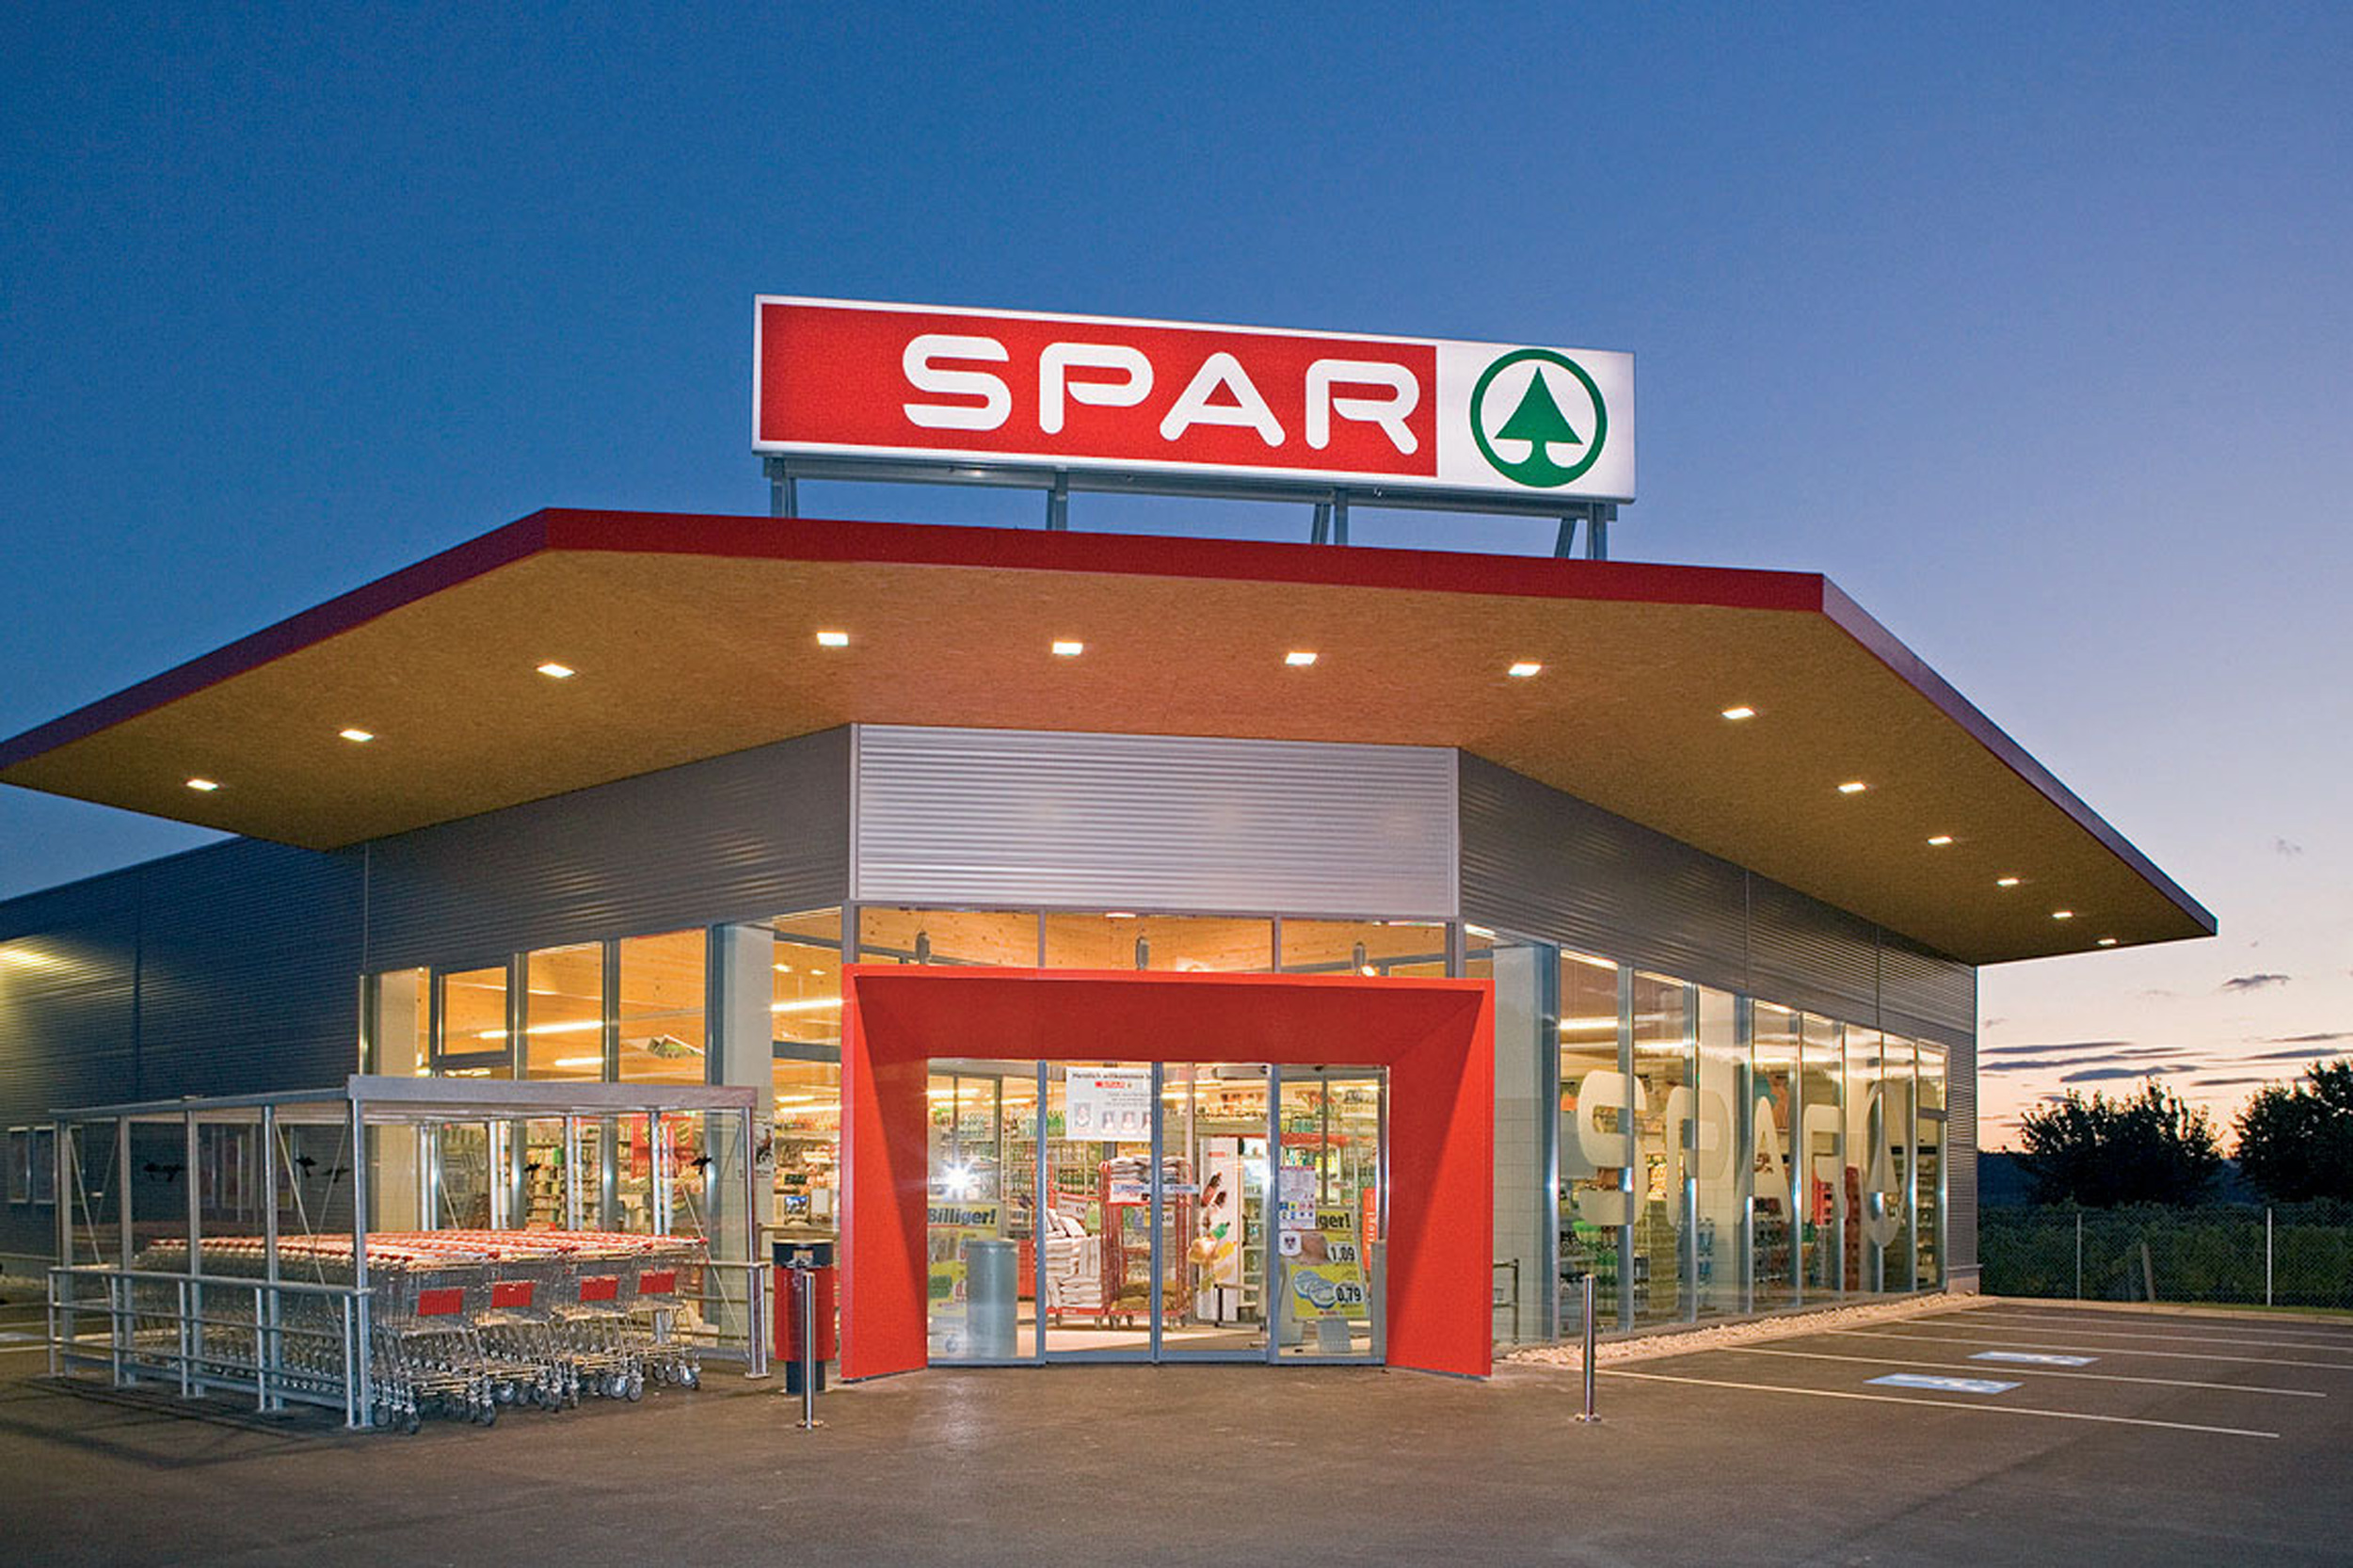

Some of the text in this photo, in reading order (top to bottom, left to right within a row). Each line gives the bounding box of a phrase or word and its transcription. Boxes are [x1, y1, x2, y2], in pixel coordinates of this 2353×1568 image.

[903, 334, 1418, 454] SPAR
[928, 1208, 996, 1224] Billiger!
[1336, 1287, 1361, 1303] 0,79
